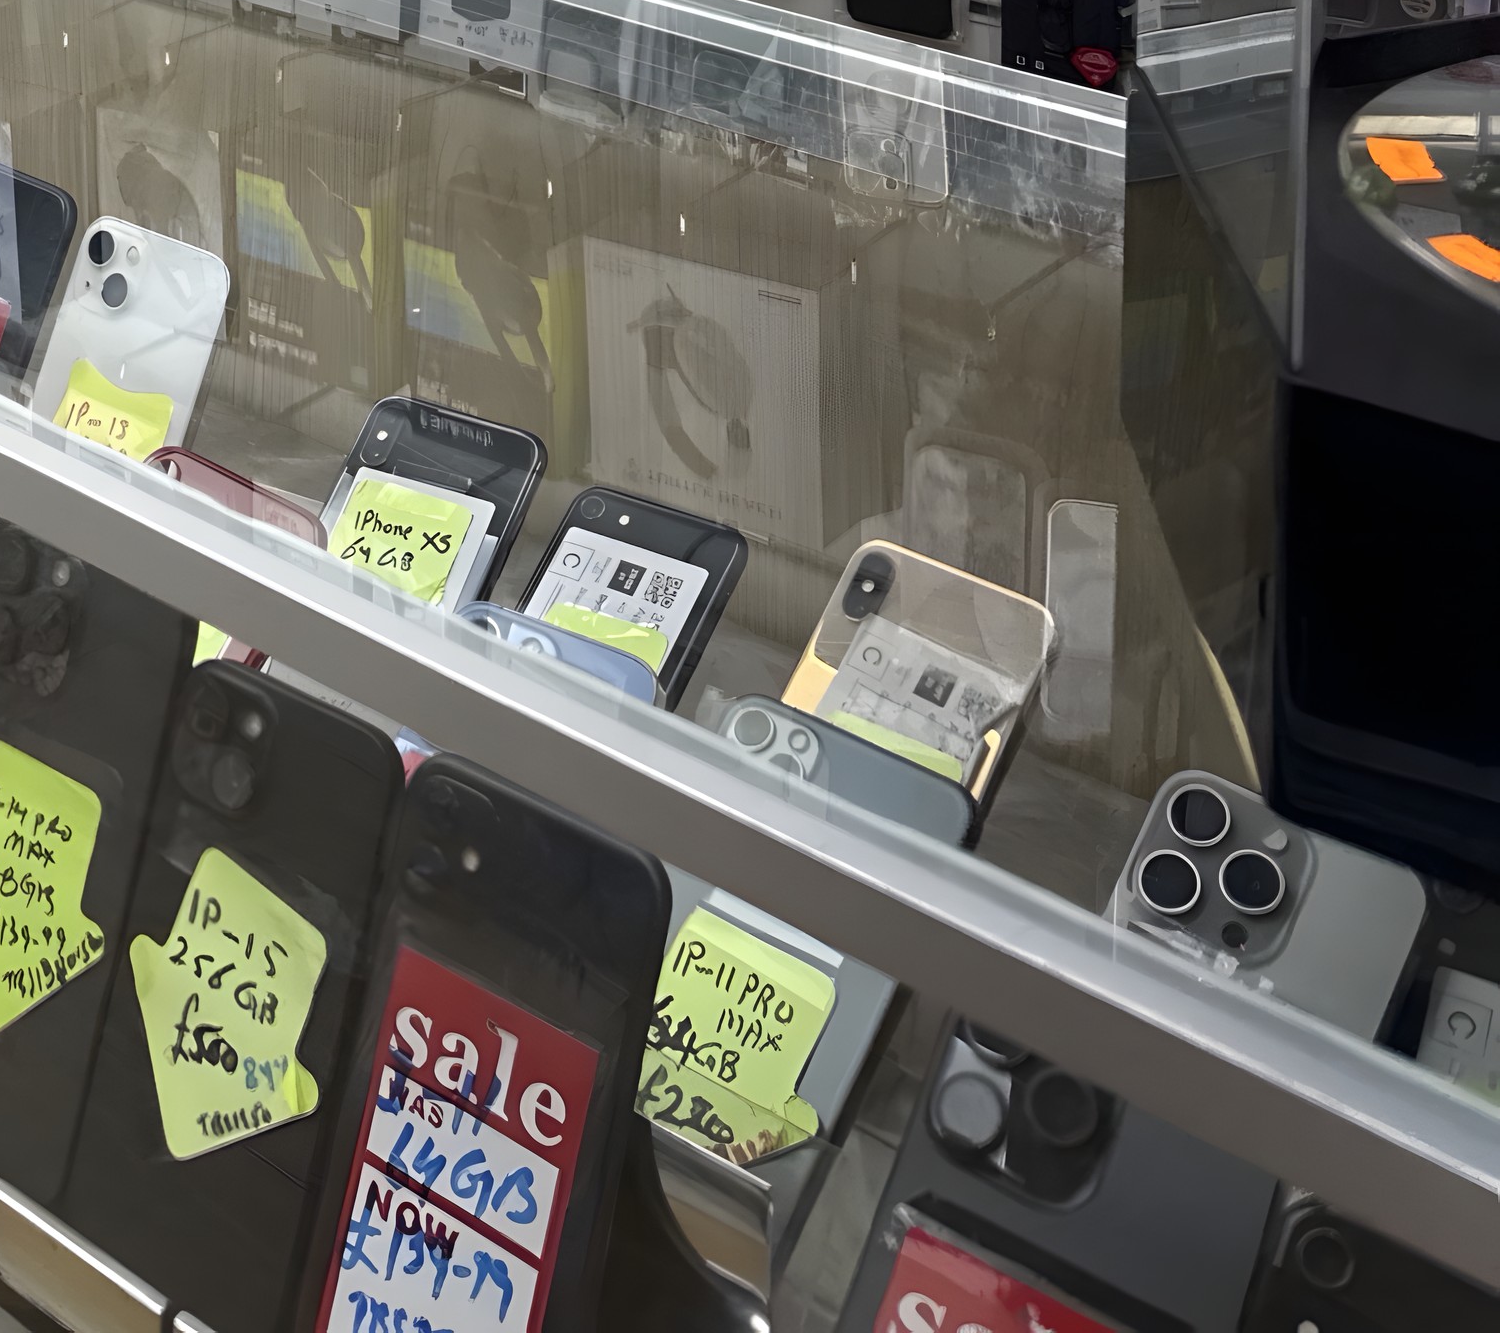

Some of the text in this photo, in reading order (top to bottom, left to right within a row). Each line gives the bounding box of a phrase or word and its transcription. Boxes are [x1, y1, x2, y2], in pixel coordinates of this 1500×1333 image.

[169, 936, 278, 1025] 256 GB
[717, 1008, 782, 1052] MAX
[389, 1006, 567, 1147] sale
[366, 1180, 460, 1260] NOW
